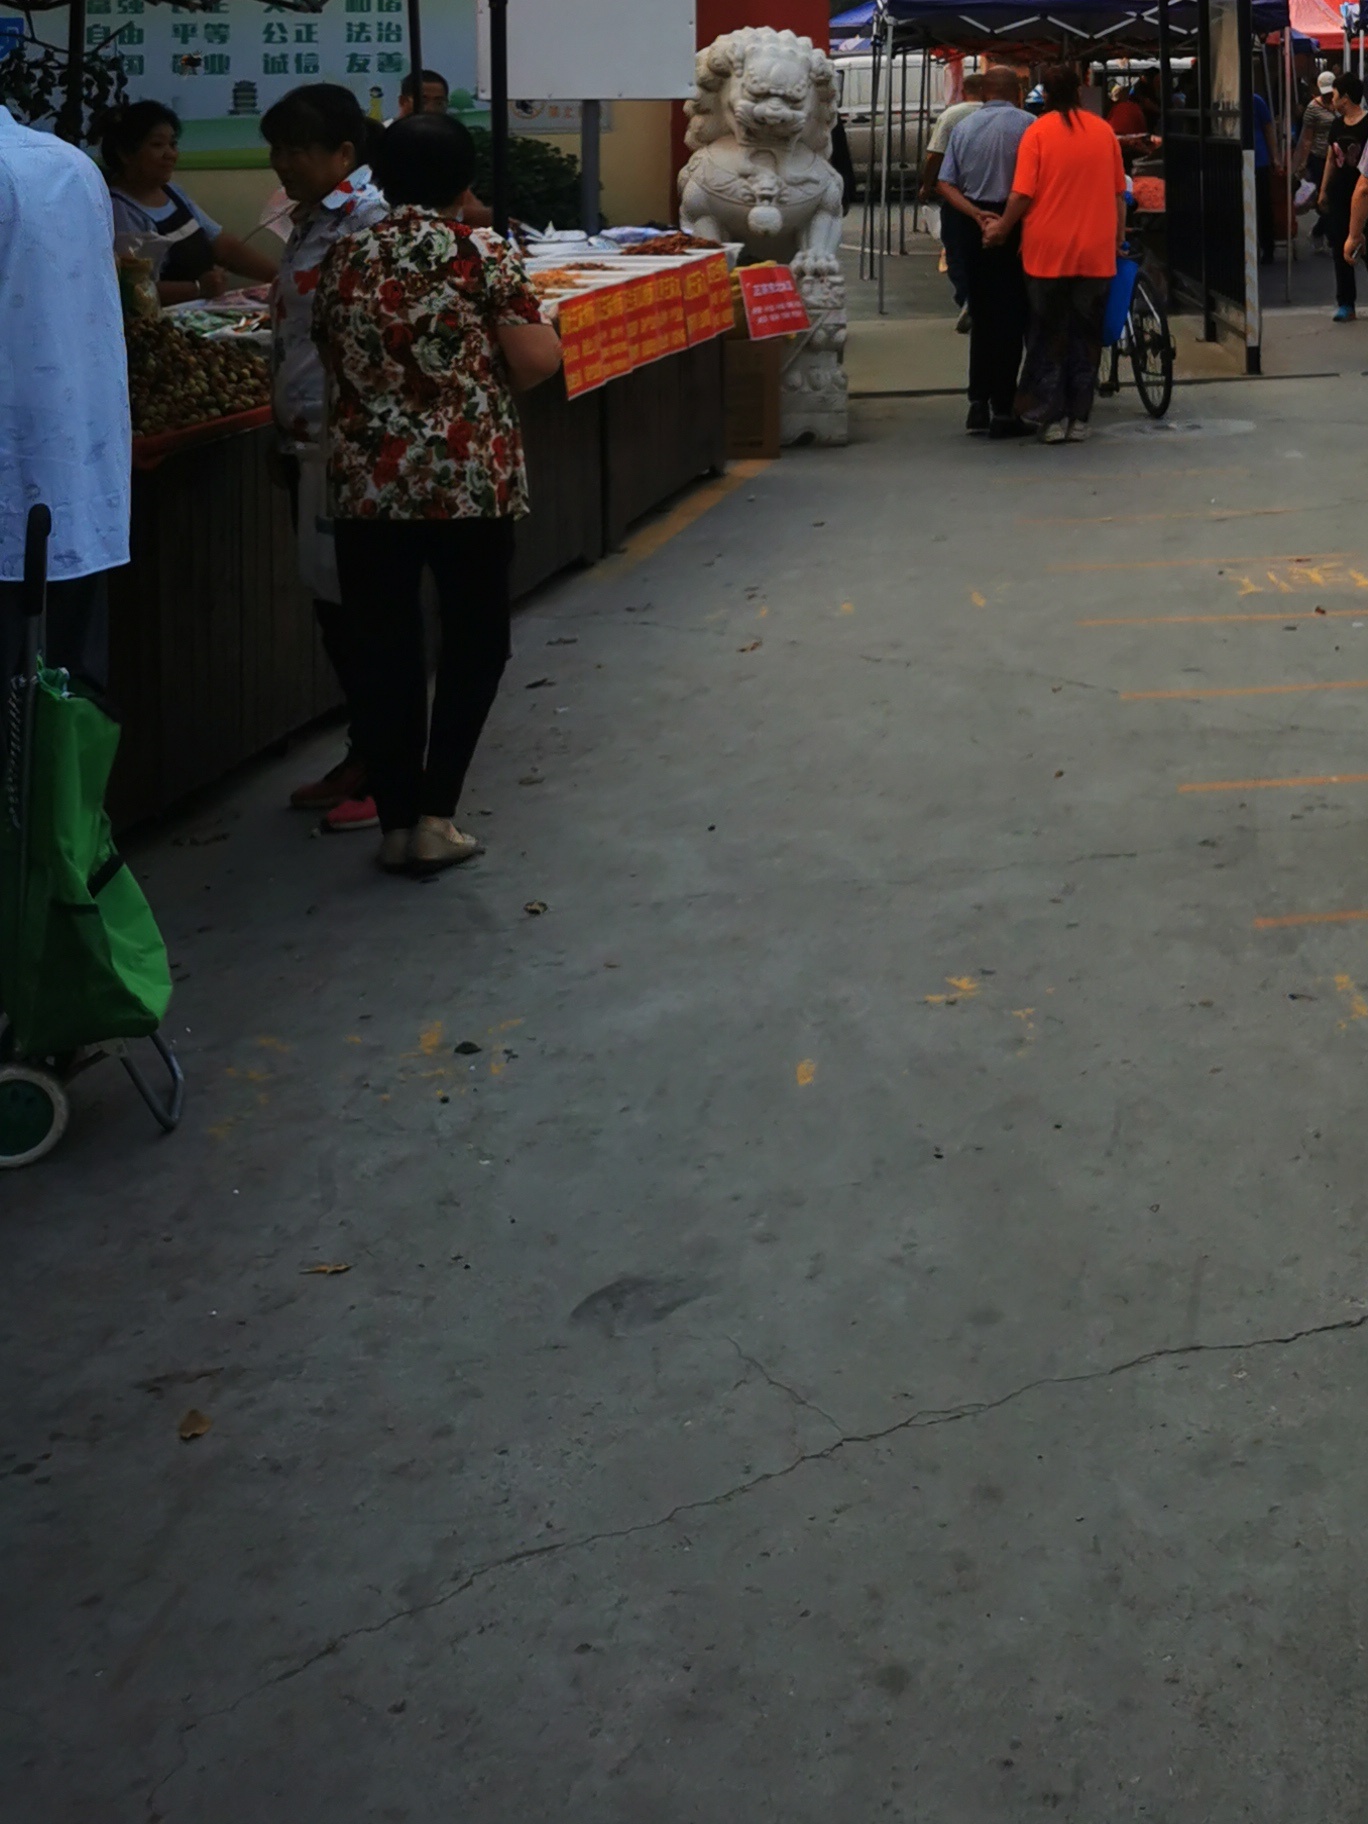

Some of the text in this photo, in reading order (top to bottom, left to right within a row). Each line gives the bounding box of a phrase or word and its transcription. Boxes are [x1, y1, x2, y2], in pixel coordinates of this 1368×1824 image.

[86, 21, 402, 45] 自由 平等 公正 法治
[263, 52, 320, 74] 诚信
[346, 52, 403, 74] 友善
